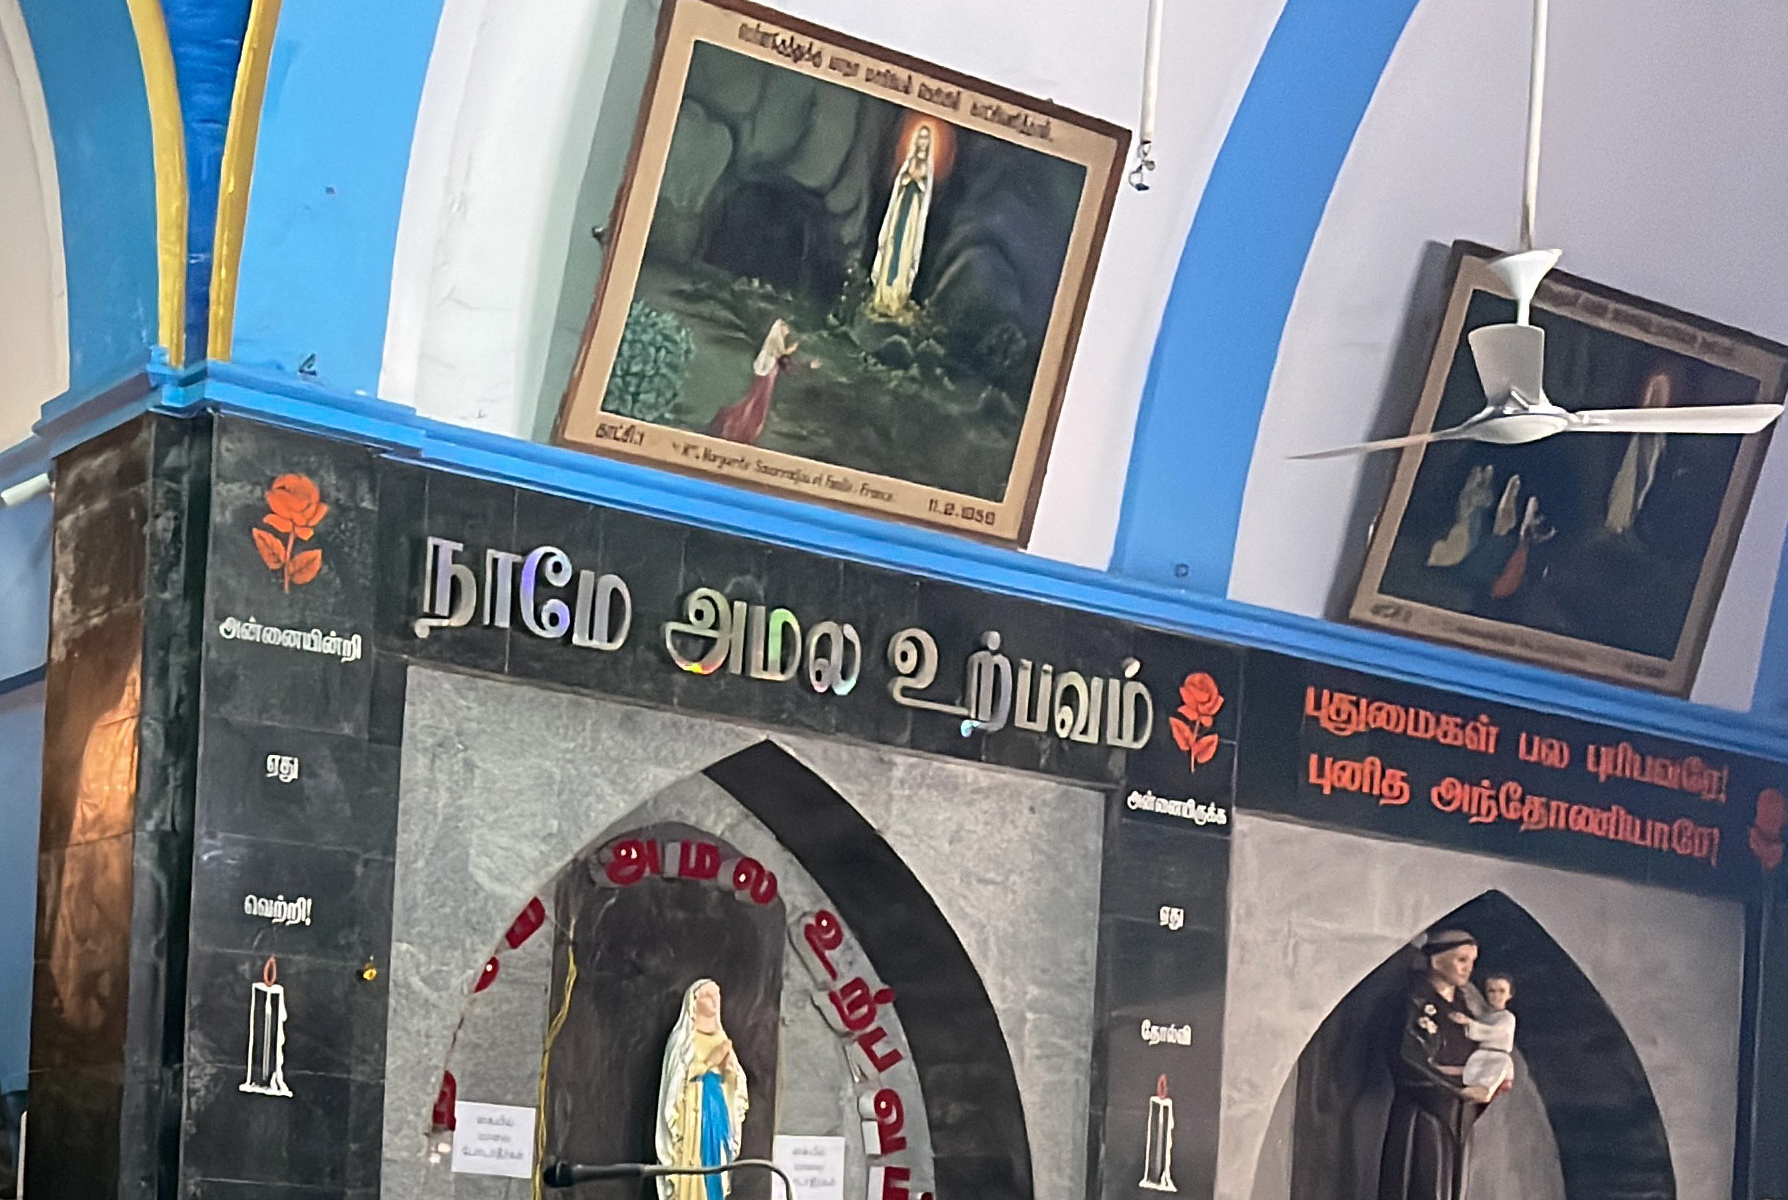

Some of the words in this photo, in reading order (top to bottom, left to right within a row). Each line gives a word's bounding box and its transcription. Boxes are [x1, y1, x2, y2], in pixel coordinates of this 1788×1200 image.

[219, 615, 362, 662] அன்னையின்றி
[412, 535, 634, 655] நாமே
[665, 587, 862, 696] அமல
[887, 628, 1154, 752] உற்பவம்
[1305, 686, 1500, 754] புதுமைகள்
[1518, 730, 1570, 769] பல
[265, 752, 300, 781] ஏது
[1309, 753, 1410, 806] புனித
[1430, 776, 1721, 866] அந்தோணியாரே!
[606, 838, 779, 903] அமல
[244, 894, 312, 926] வெற்றி!
